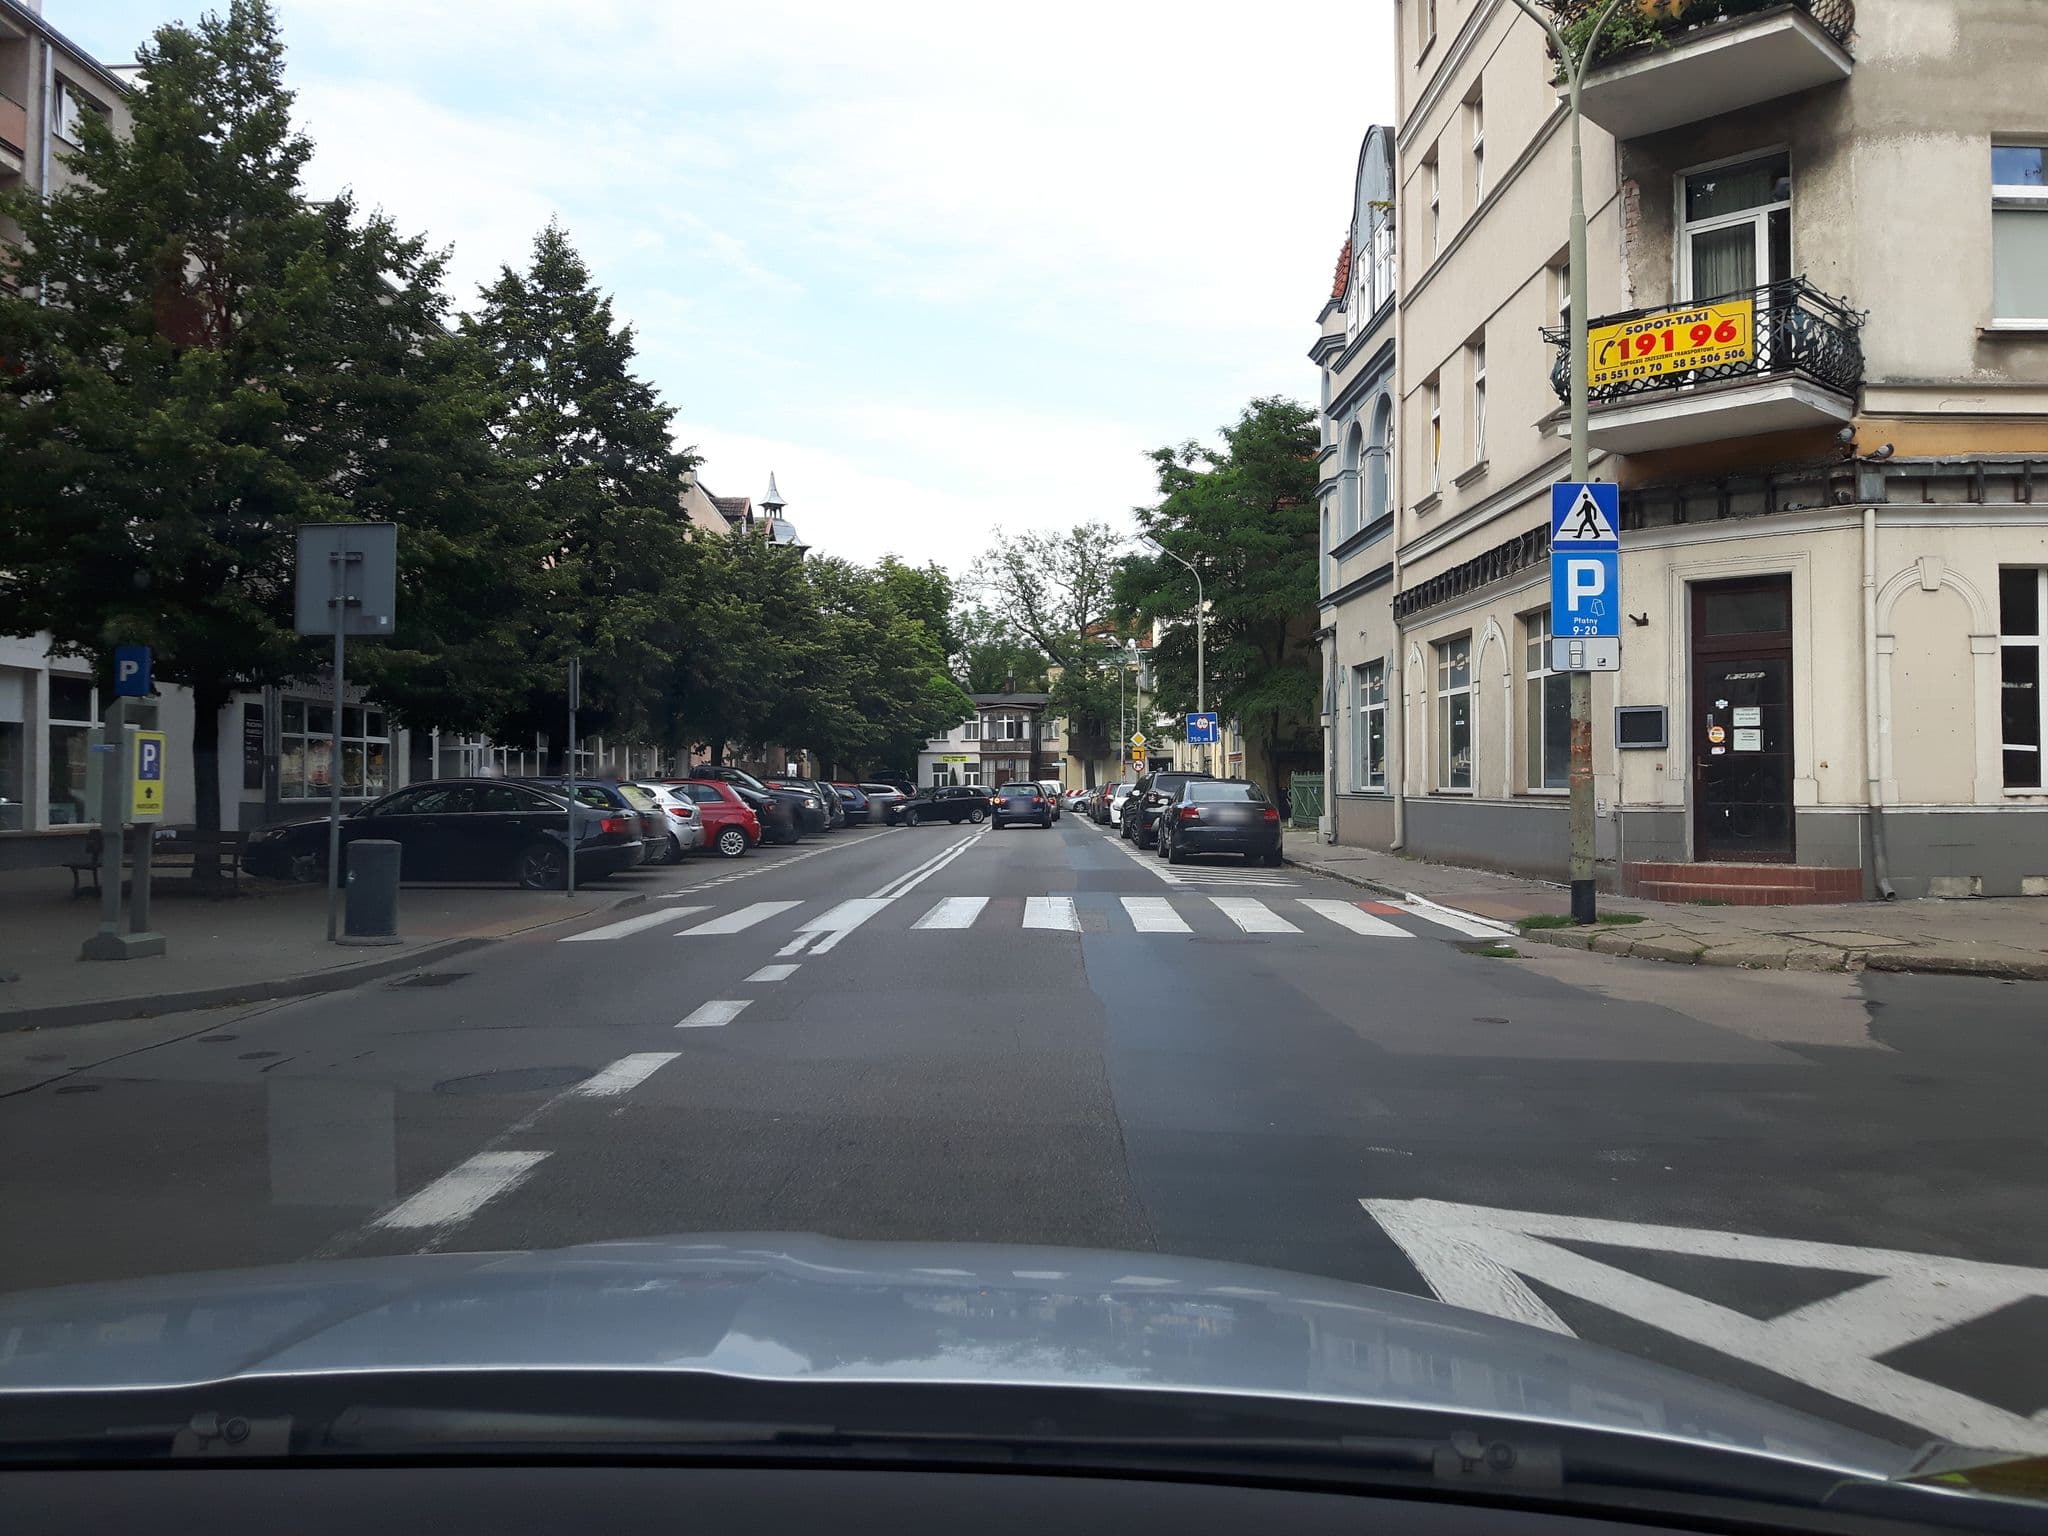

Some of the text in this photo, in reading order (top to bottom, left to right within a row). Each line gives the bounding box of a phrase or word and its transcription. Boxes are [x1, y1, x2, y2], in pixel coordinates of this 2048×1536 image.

[1625, 312, 1709, 335] SOPOT-TAXI
[1617, 319, 1737, 361] 191 96
[1595, 372, 1607, 382] 58
[1611, 368, 1629, 379] 551
[1633, 365, 1646, 375] 02
[1649, 362, 1662, 372] 70
[1672, 359, 1686, 369] 58
[1724, 348, 1745, 360] 506
[1568, 559, 1605, 612] P
[1572, 625, 1598, 635] 9-20
[119, 660, 139, 682] P
[143, 743, 156, 772] P
